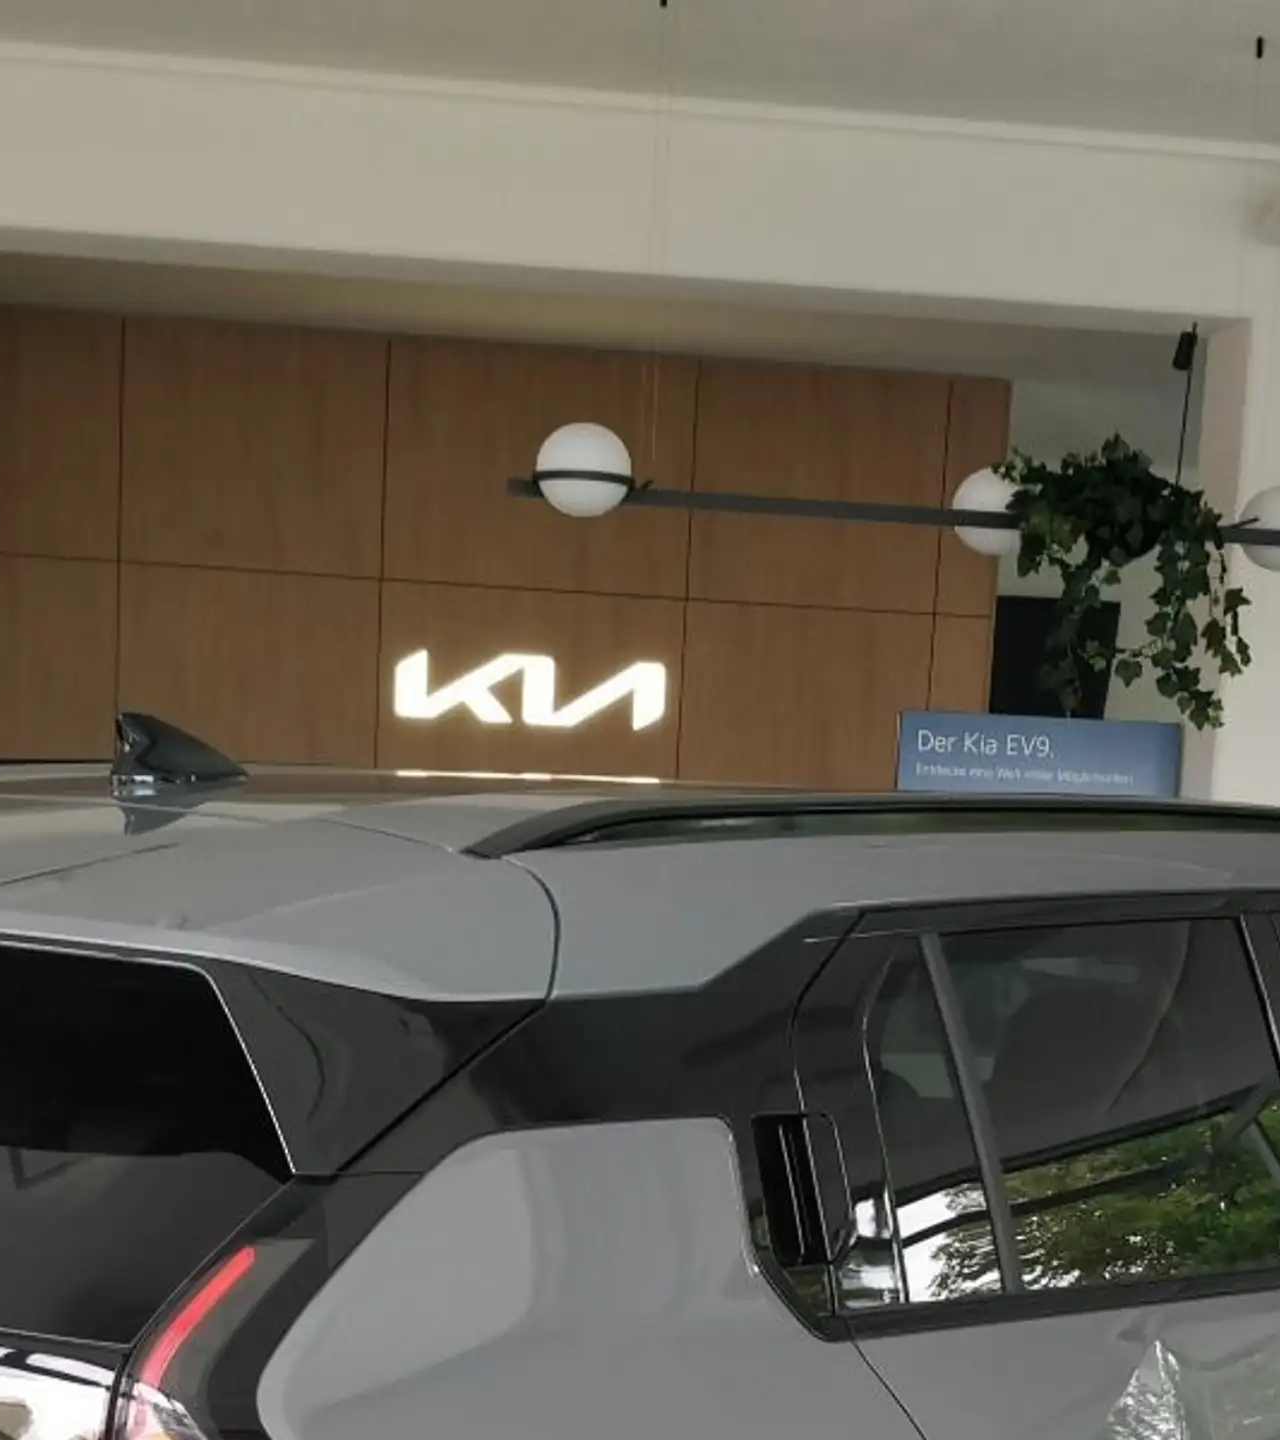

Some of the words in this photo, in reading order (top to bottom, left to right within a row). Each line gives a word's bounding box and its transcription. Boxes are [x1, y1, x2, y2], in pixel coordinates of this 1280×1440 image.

[393, 647, 667, 732] KIA
[917, 729, 955, 753] Der
[963, 731, 999, 756] Kia
[1006, 734, 1055, 759] EV9.
